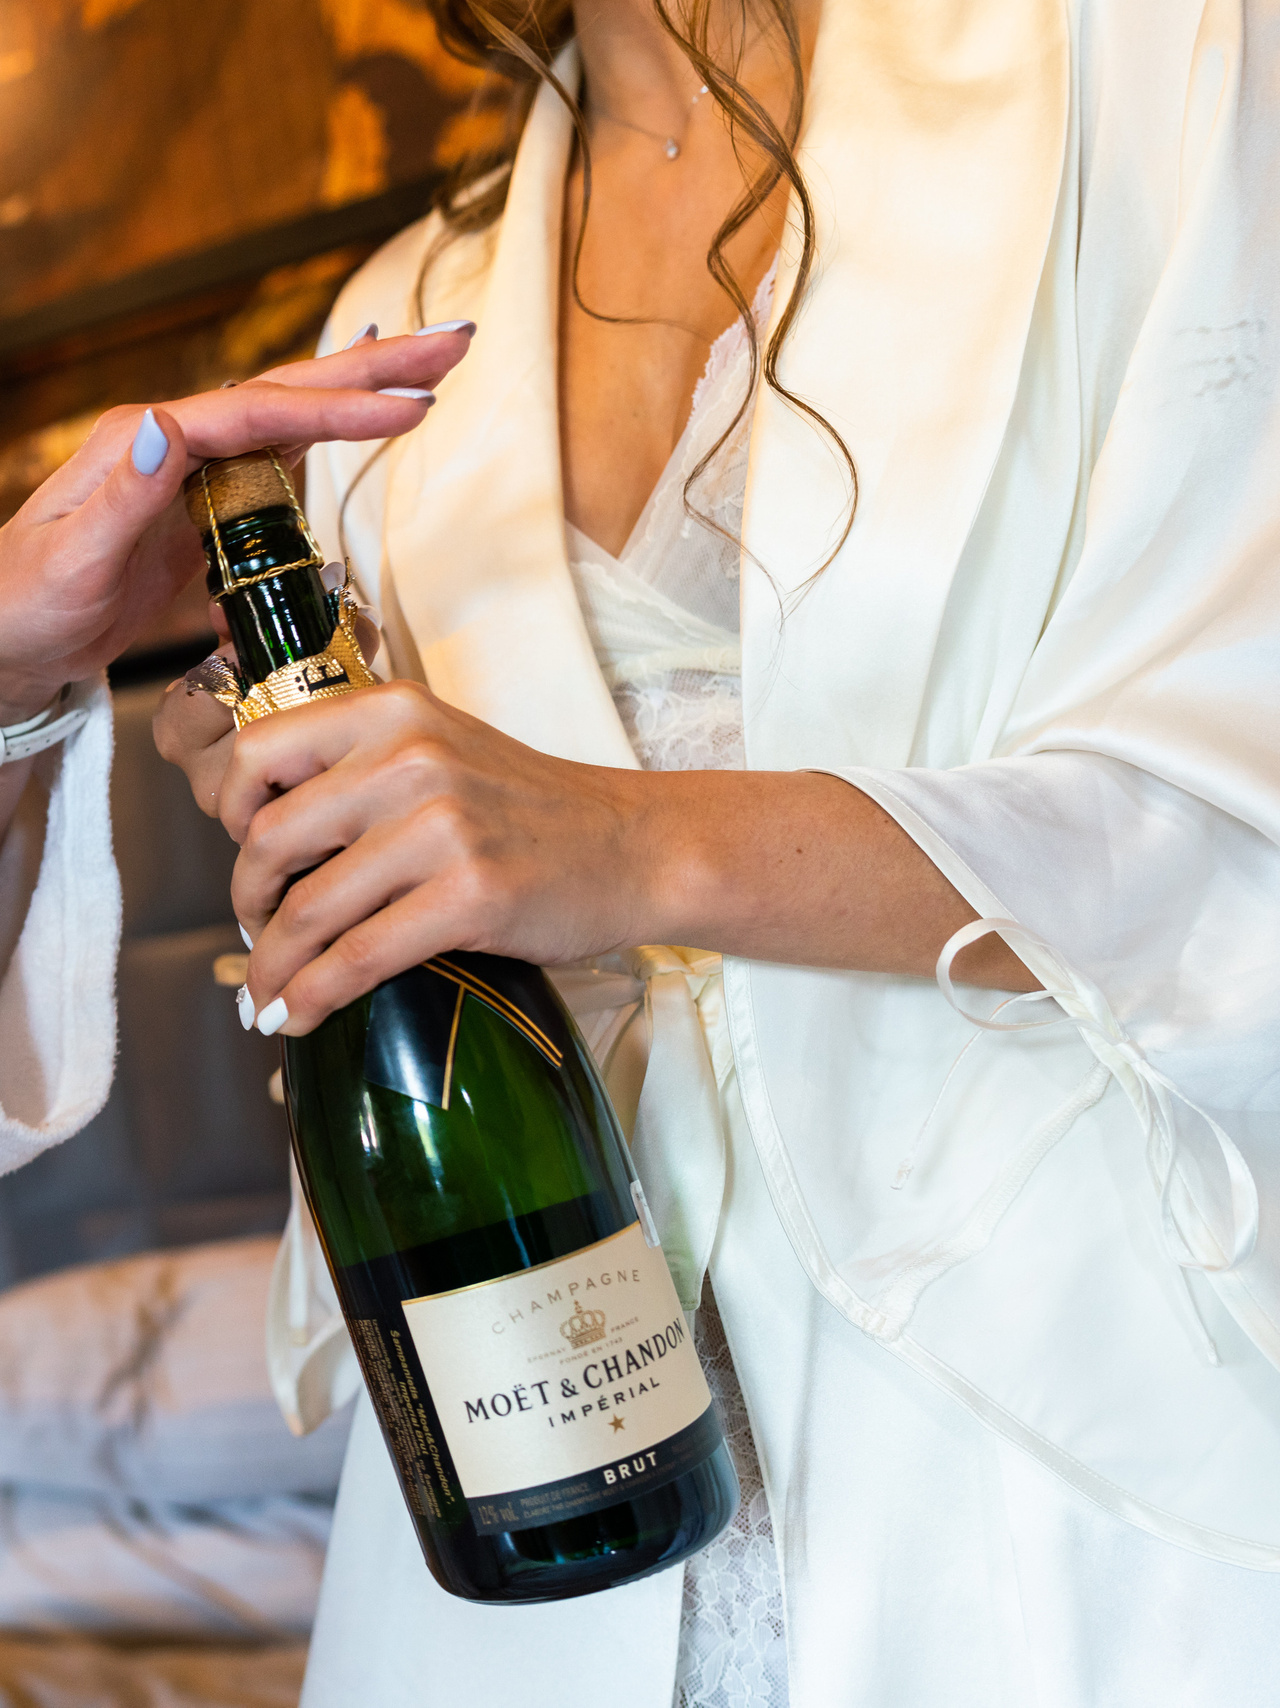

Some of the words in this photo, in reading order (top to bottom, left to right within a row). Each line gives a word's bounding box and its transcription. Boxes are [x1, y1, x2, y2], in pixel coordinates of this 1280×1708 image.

[491, 1268, 641, 1335] CHAMPAGNE
[610, 1315, 640, 1333] FRANCE
[463, 1383, 551, 1424] MOËT
[560, 1377, 581, 1399] &
[582, 1316, 685, 1390] CHANDON
[591, 1344, 604, 1355] EN
[399, 1380, 420, 1428] Imperial
[414, 1429, 430, 1456] Brut
[548, 1375, 661, 1428] IMPÉRIAL
[602, 1451, 657, 1485] BRUT
